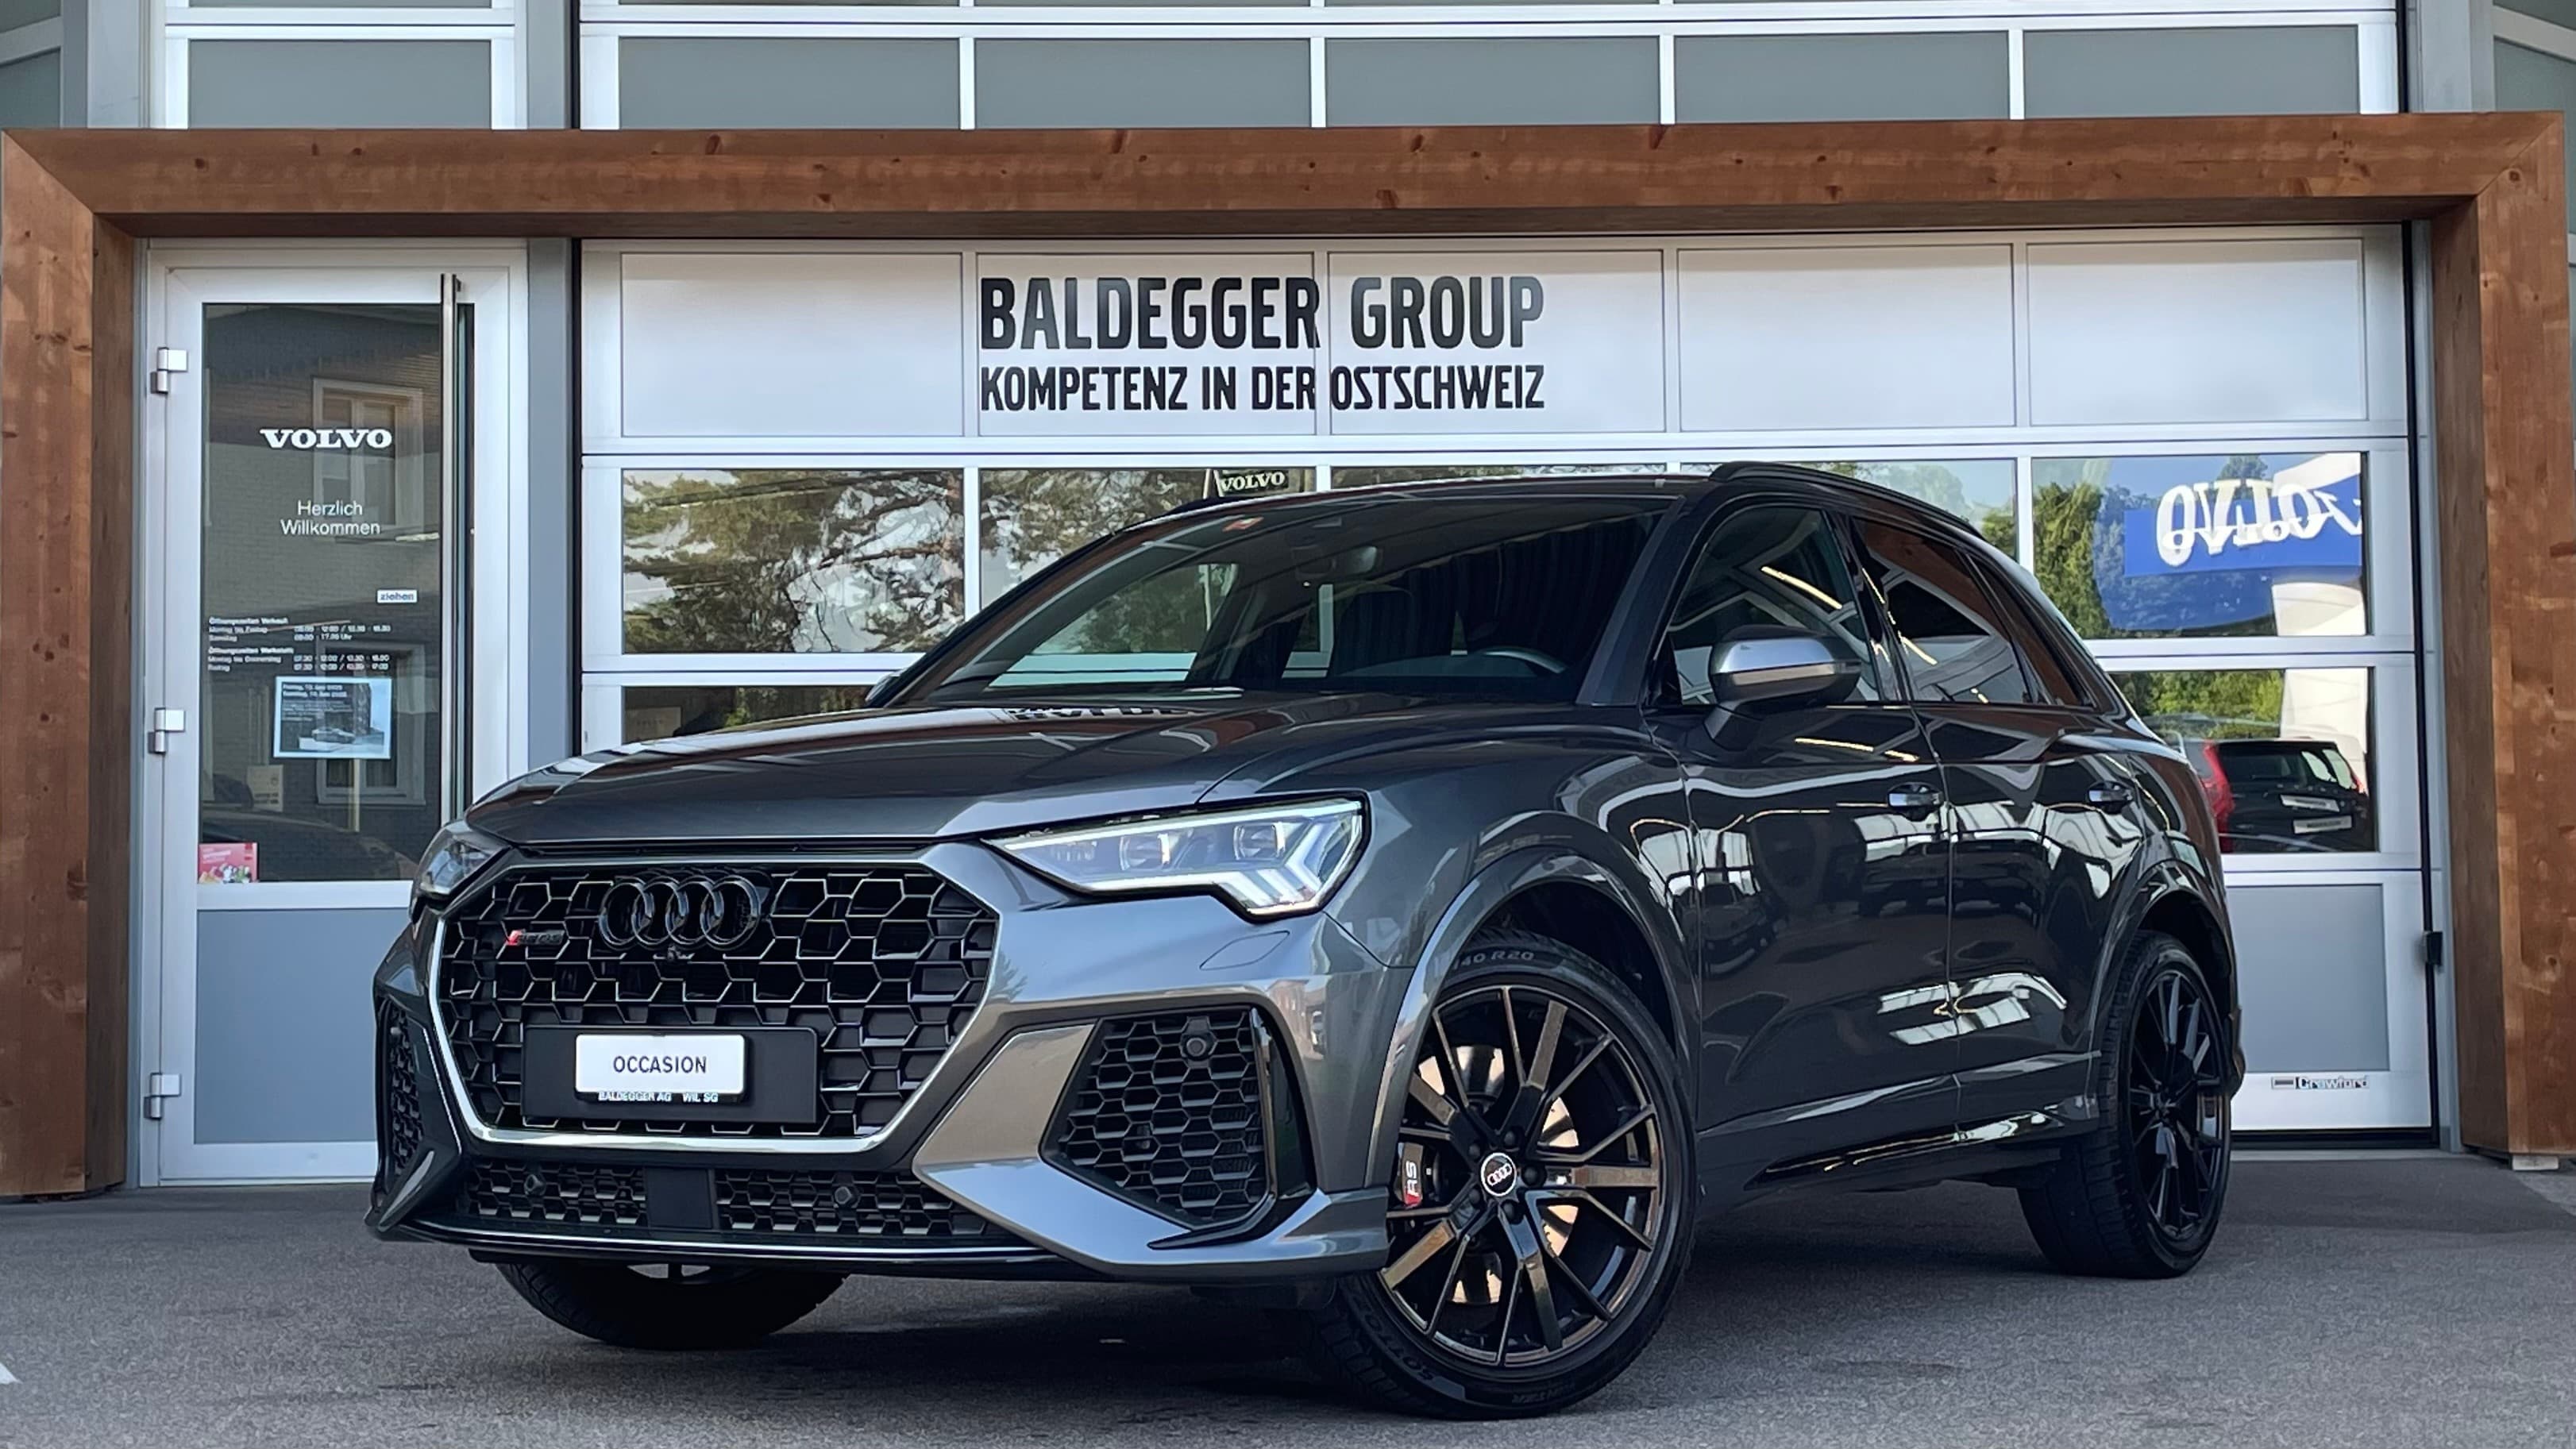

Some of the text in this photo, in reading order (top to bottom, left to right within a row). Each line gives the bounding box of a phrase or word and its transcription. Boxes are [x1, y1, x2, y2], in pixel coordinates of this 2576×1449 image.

[981, 276, 1544, 349] BALDEGGER GROUP
[981, 364, 1545, 411] KOMPETENZ IN DER OSTSCHWEIZ
[260, 429, 392, 449] VOLVO
[1220, 472, 1286, 491] VOLVO
[298, 500, 363, 515] Herzlich
[280, 519, 381, 535] Willkommen
[613, 1056, 708, 1073] OCCASION
[657, 1093, 672, 1101] AG
[682, 1093, 700, 1102] WIL
[703, 1093, 719, 1102] SG
